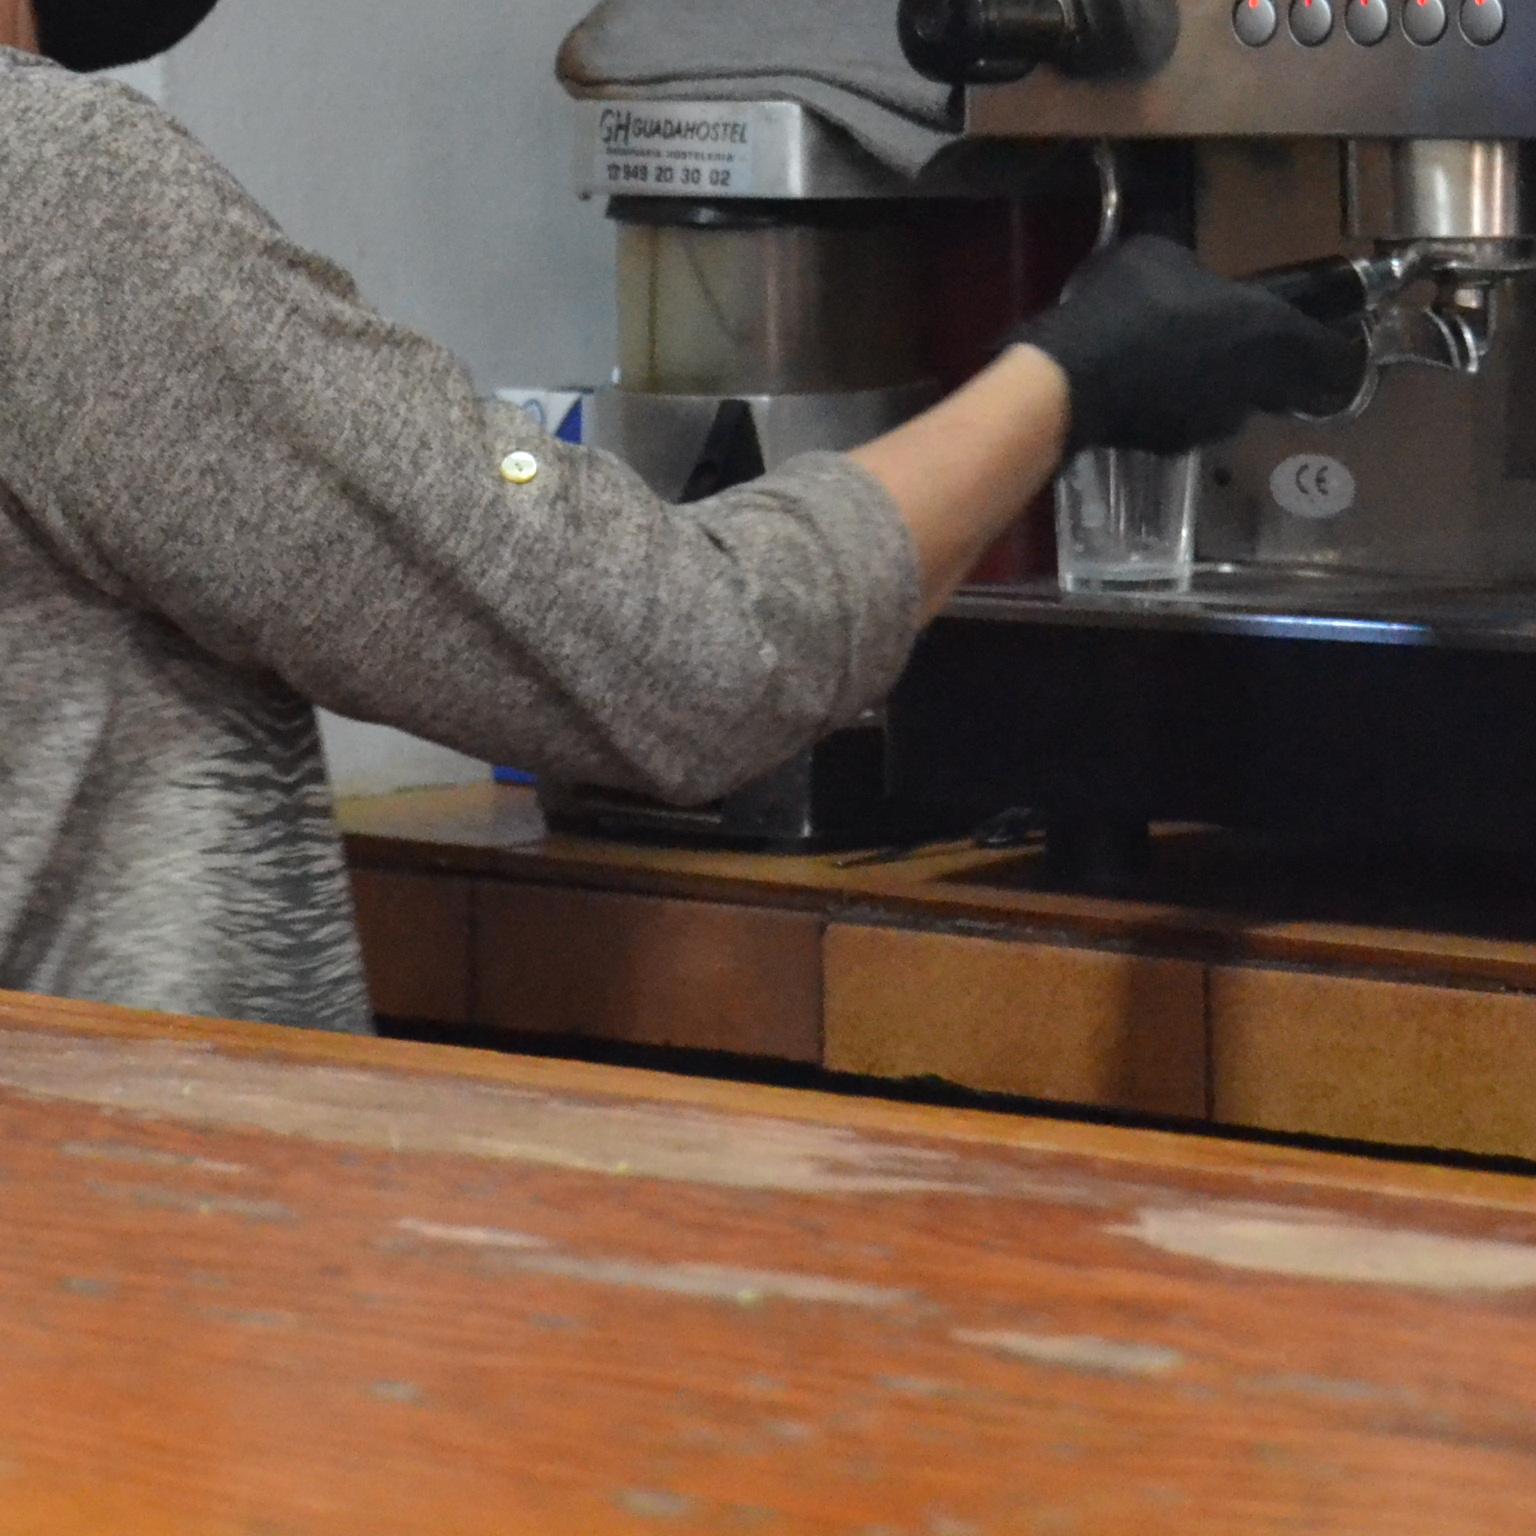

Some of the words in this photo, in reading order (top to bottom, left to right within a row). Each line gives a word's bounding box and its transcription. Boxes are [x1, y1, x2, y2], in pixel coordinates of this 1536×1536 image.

[632, 117, 748, 144] GUADAHOSTEL
[655, 165, 674, 183] 20
[680, 167, 701, 185] 30
[709, 169, 731, 186] 02
[1296, 464, 1329, 495] CE
